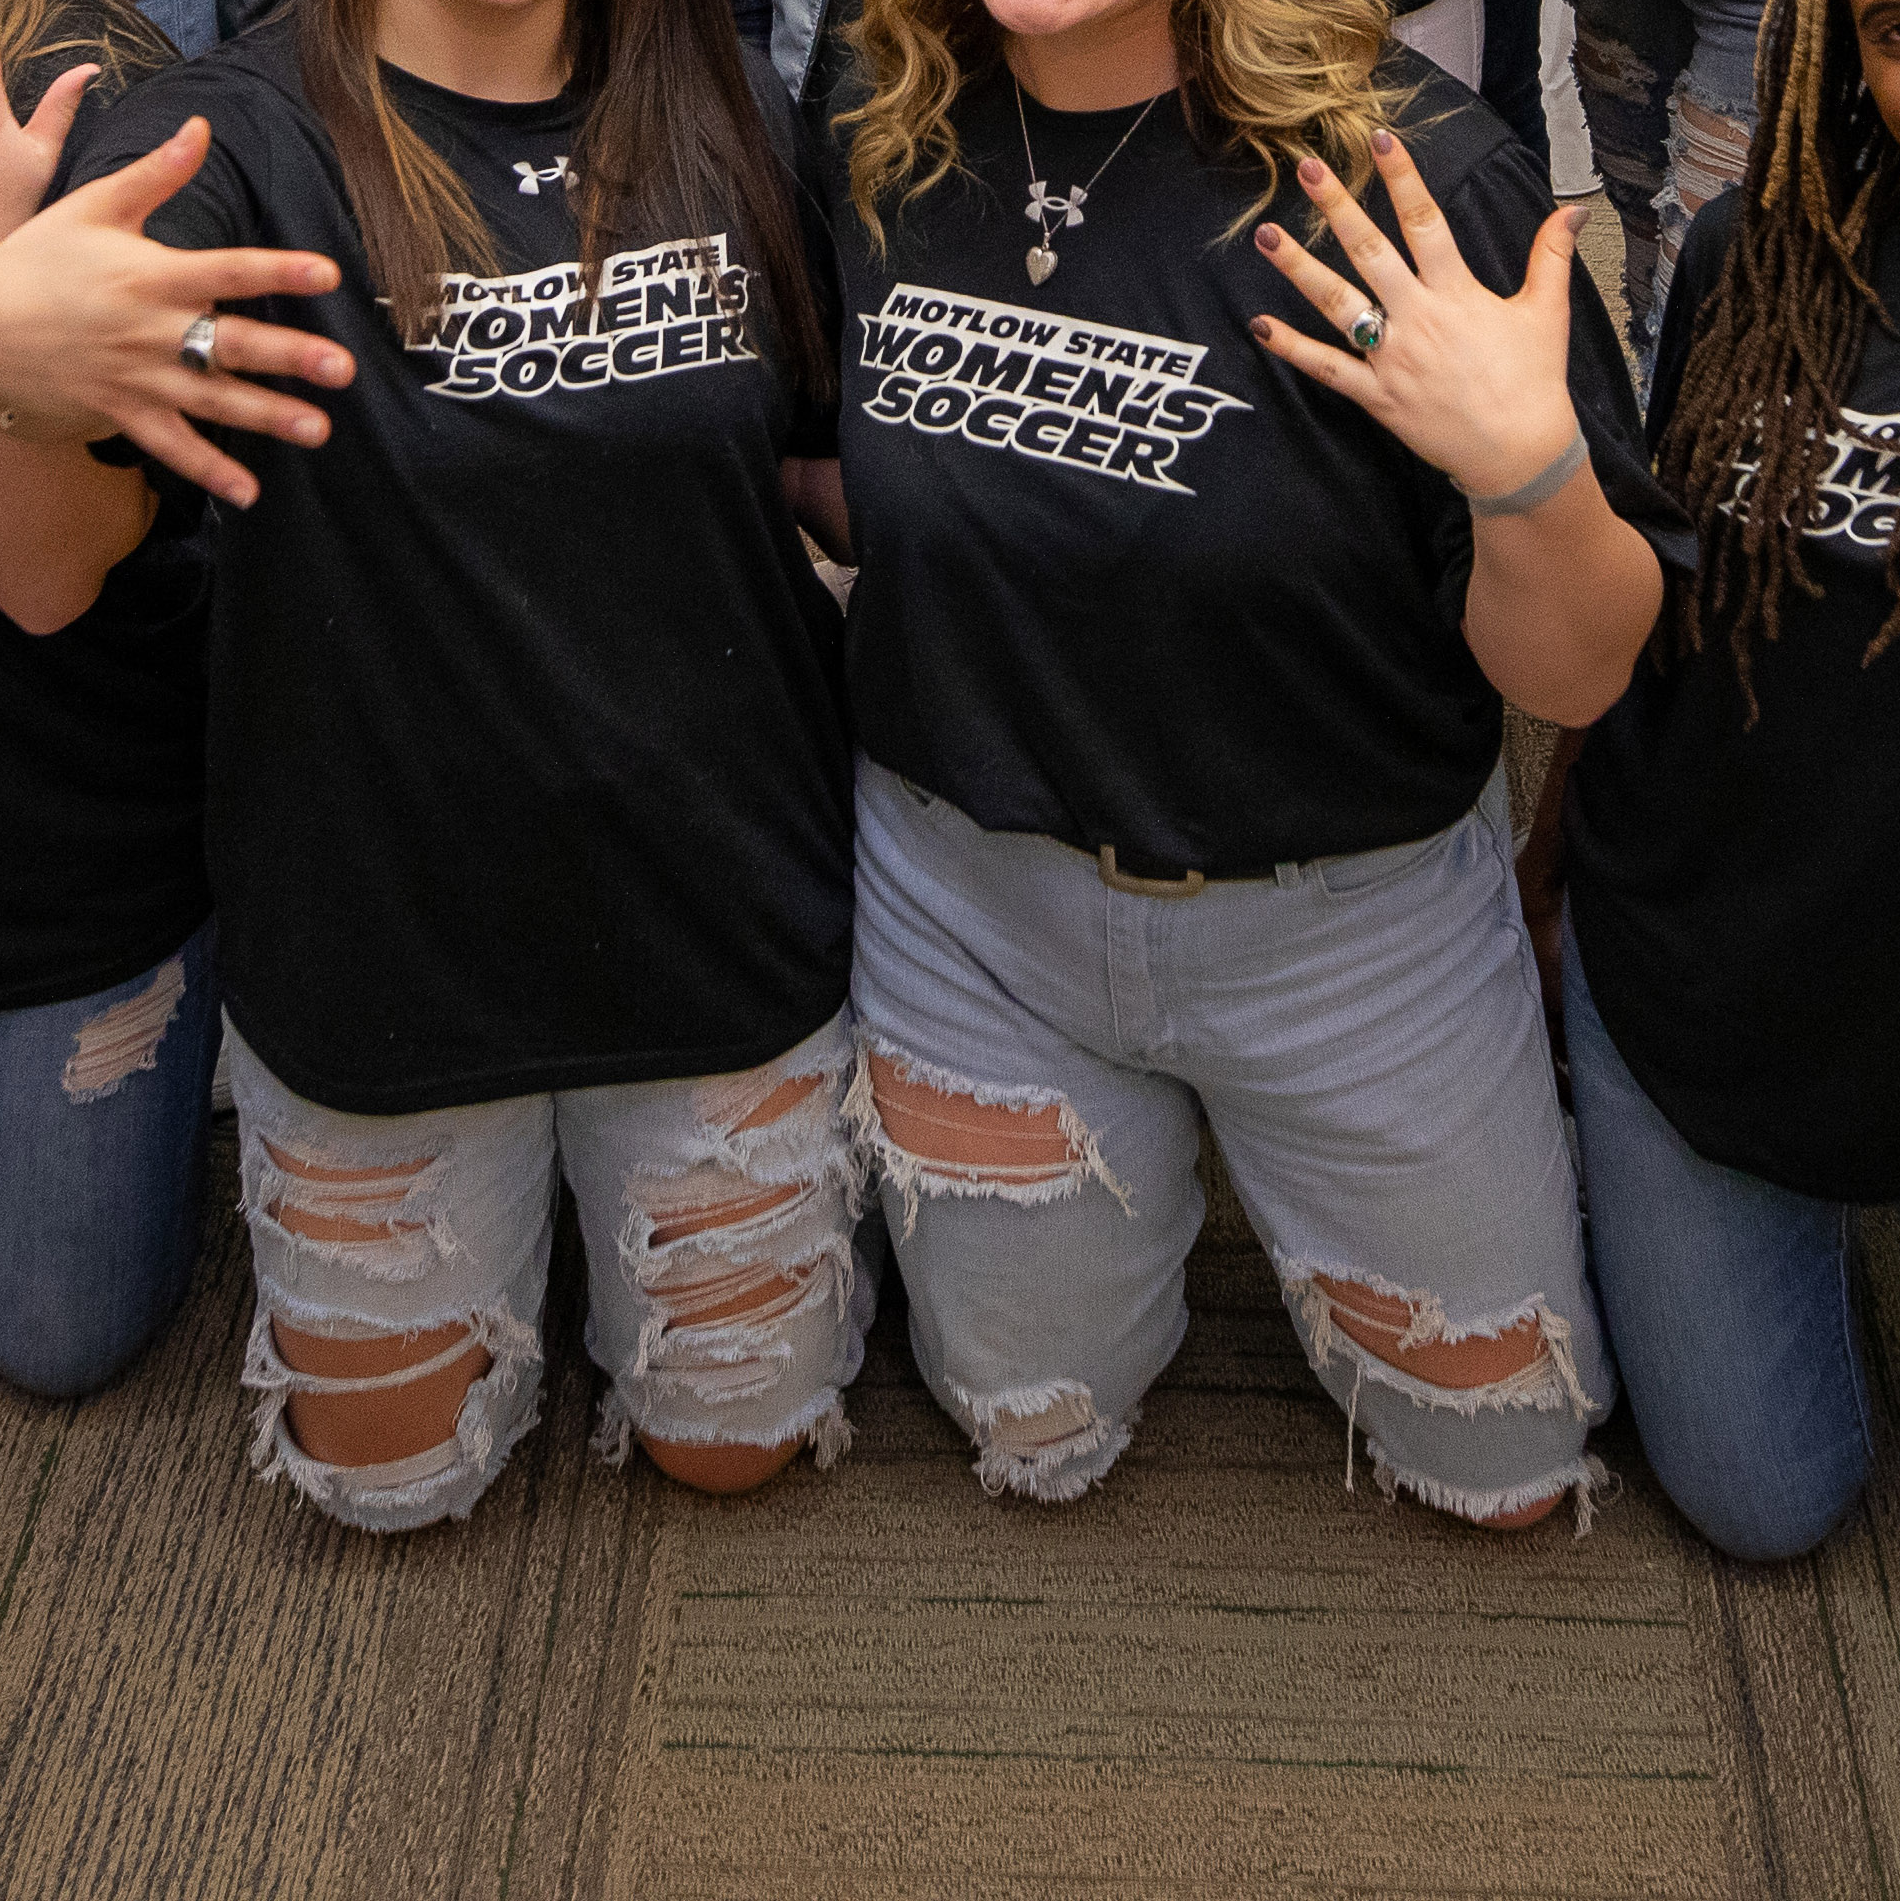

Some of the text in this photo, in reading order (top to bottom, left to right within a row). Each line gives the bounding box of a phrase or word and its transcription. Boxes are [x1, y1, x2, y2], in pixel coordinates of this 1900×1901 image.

[613, 245, 720, 285] STATE
[424, 316, 758, 399] SOCCER
[857, 313, 1254, 440] WOMEN'S
[887, 294, 1194, 376] MOTLOW STATE
[862, 370, 1197, 496] SOCCER
